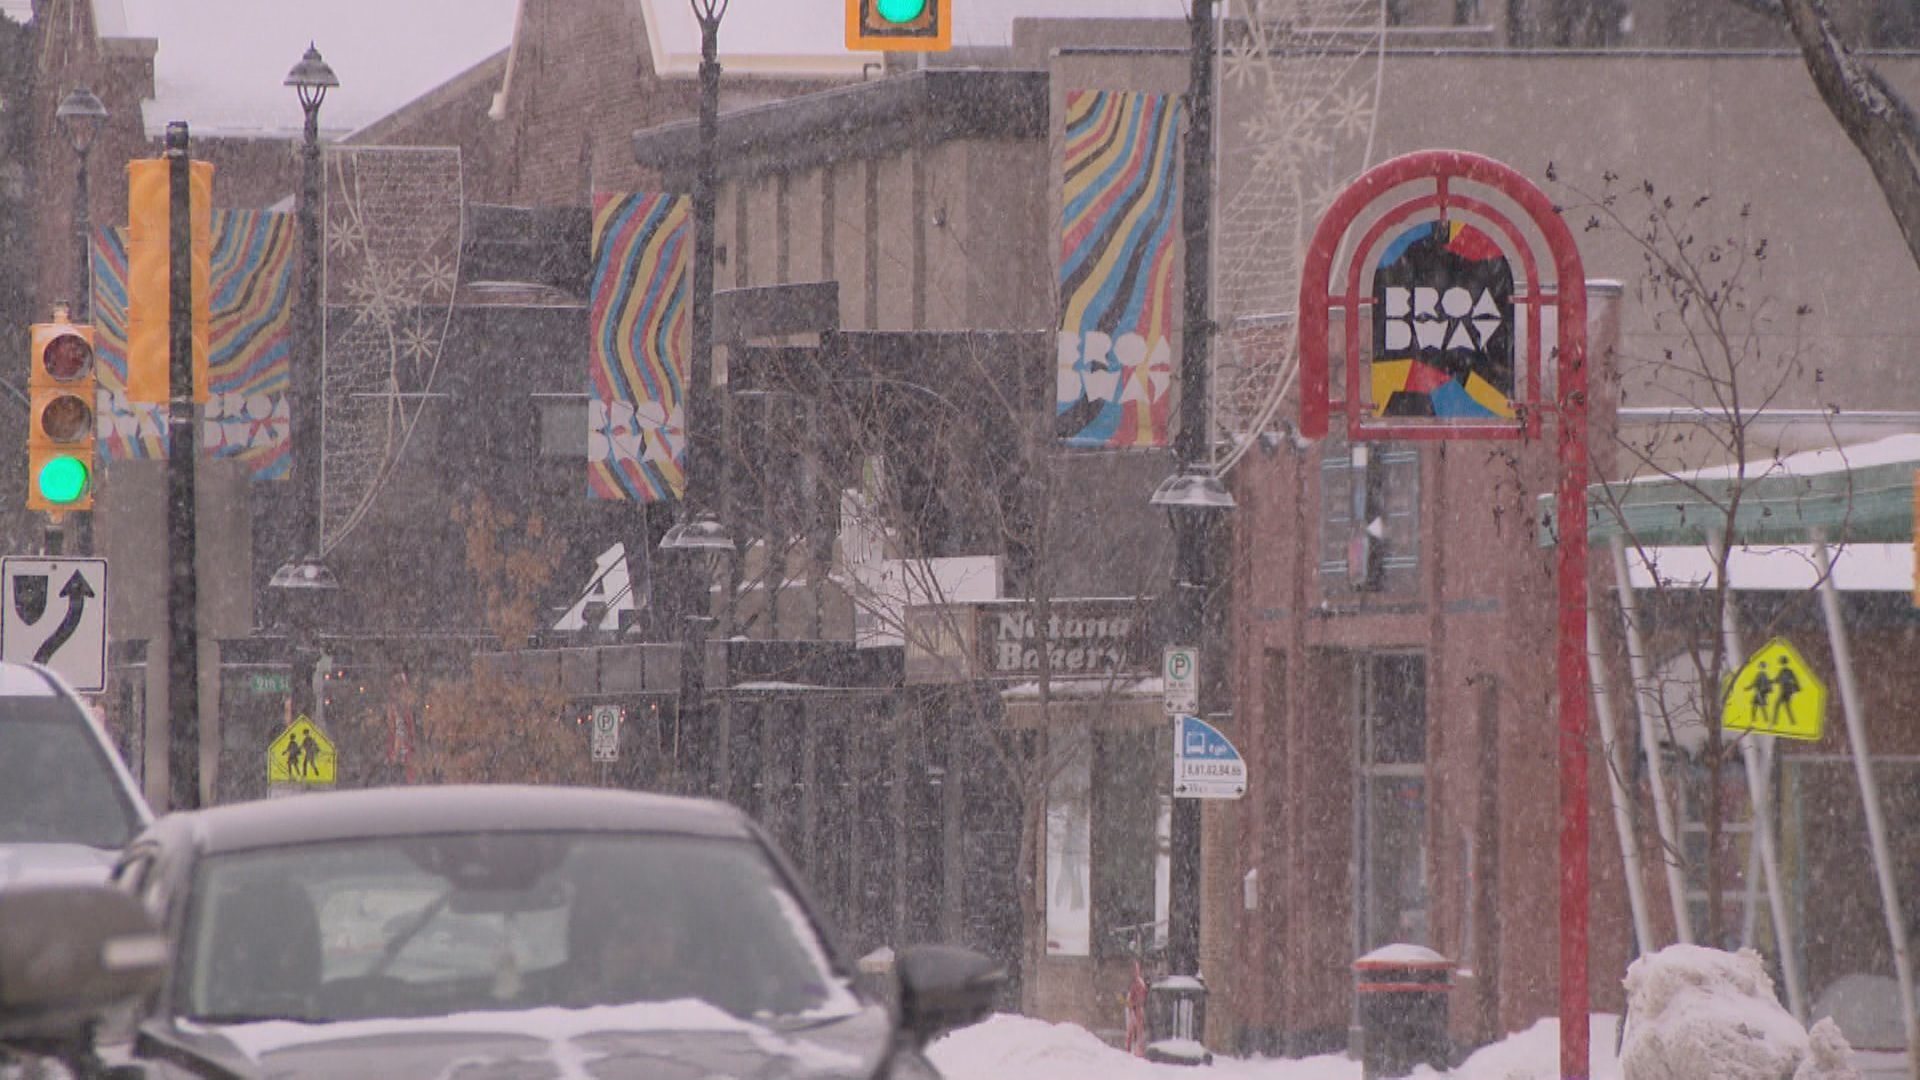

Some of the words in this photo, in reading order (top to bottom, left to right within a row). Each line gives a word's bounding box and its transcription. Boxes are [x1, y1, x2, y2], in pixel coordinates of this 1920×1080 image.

[1386, 287, 1501, 319] BROA
[1057, 330, 1170, 366] BROA
[1386, 319, 1502, 352] DWAY
[1057, 367, 1170, 404] DWAY
